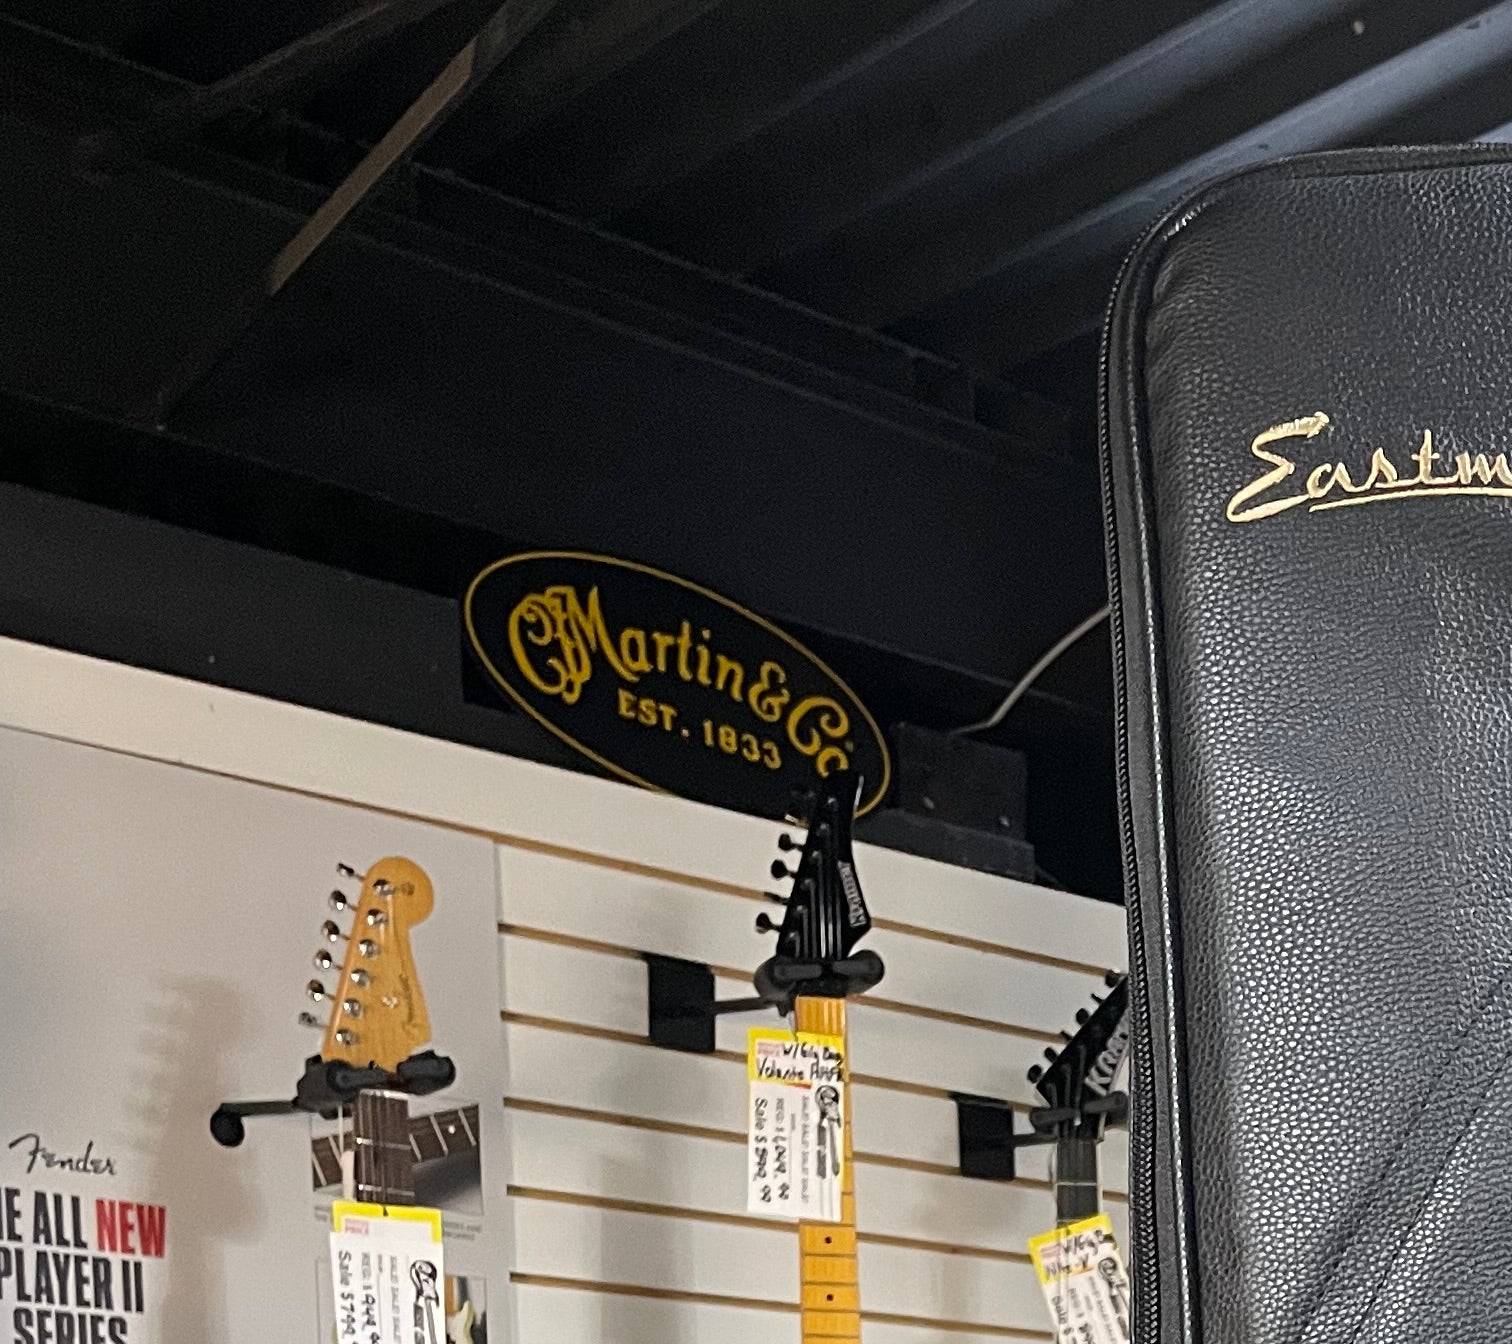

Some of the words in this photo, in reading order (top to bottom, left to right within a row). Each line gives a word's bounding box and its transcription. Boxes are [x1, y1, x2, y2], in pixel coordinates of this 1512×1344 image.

[617, 687, 691, 738] EST.
[703, 719, 783, 771] 1833
[8, 1133, 117, 1177] Fender
[33, 1190, 88, 1249] ALL
[96, 1197, 167, 1259] NEW
[0, 1246, 114, 1310] PLAYER
[338, 1250, 352, 1287] Sale
